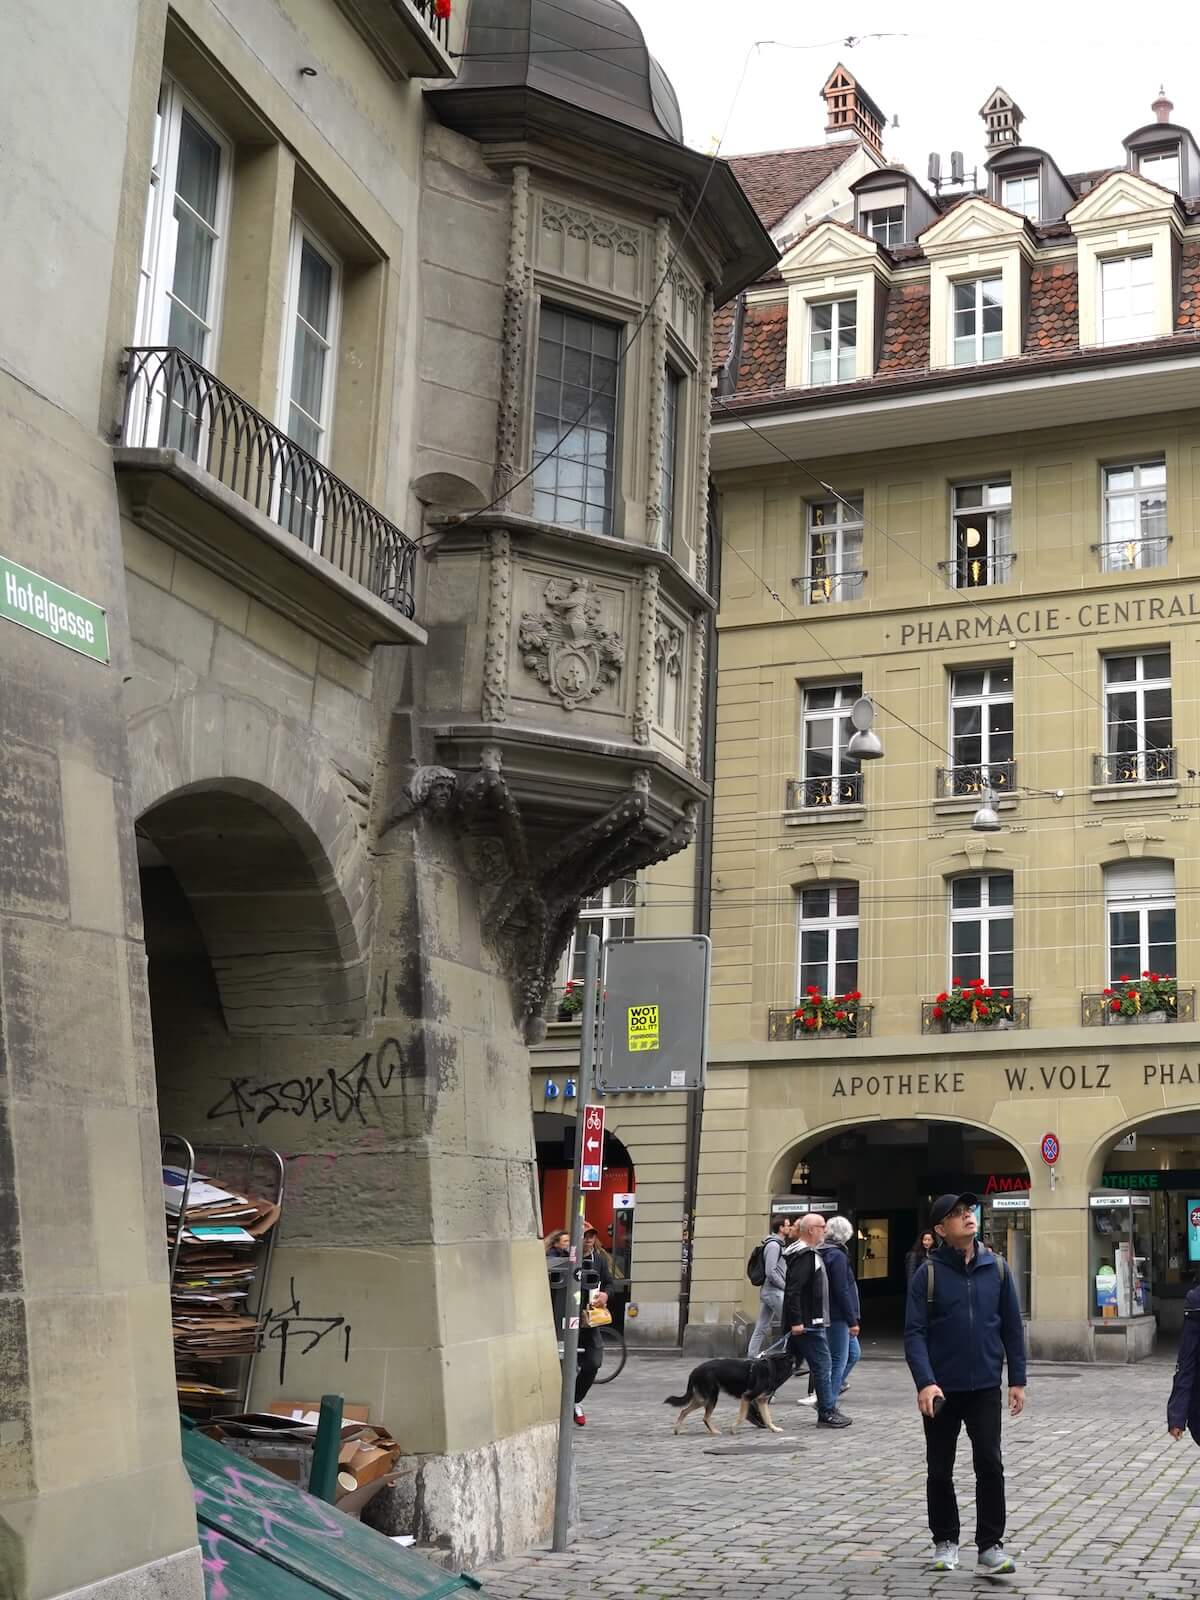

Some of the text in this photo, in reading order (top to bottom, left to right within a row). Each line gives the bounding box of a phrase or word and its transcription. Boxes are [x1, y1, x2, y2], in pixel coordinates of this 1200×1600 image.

[5, 570, 95, 644] Hotelgasse
[631, 1007, 657, 1016] WOT
[631, 1016, 657, 1026] DO U
[832, 1073, 965, 1097] APOTHEKE
